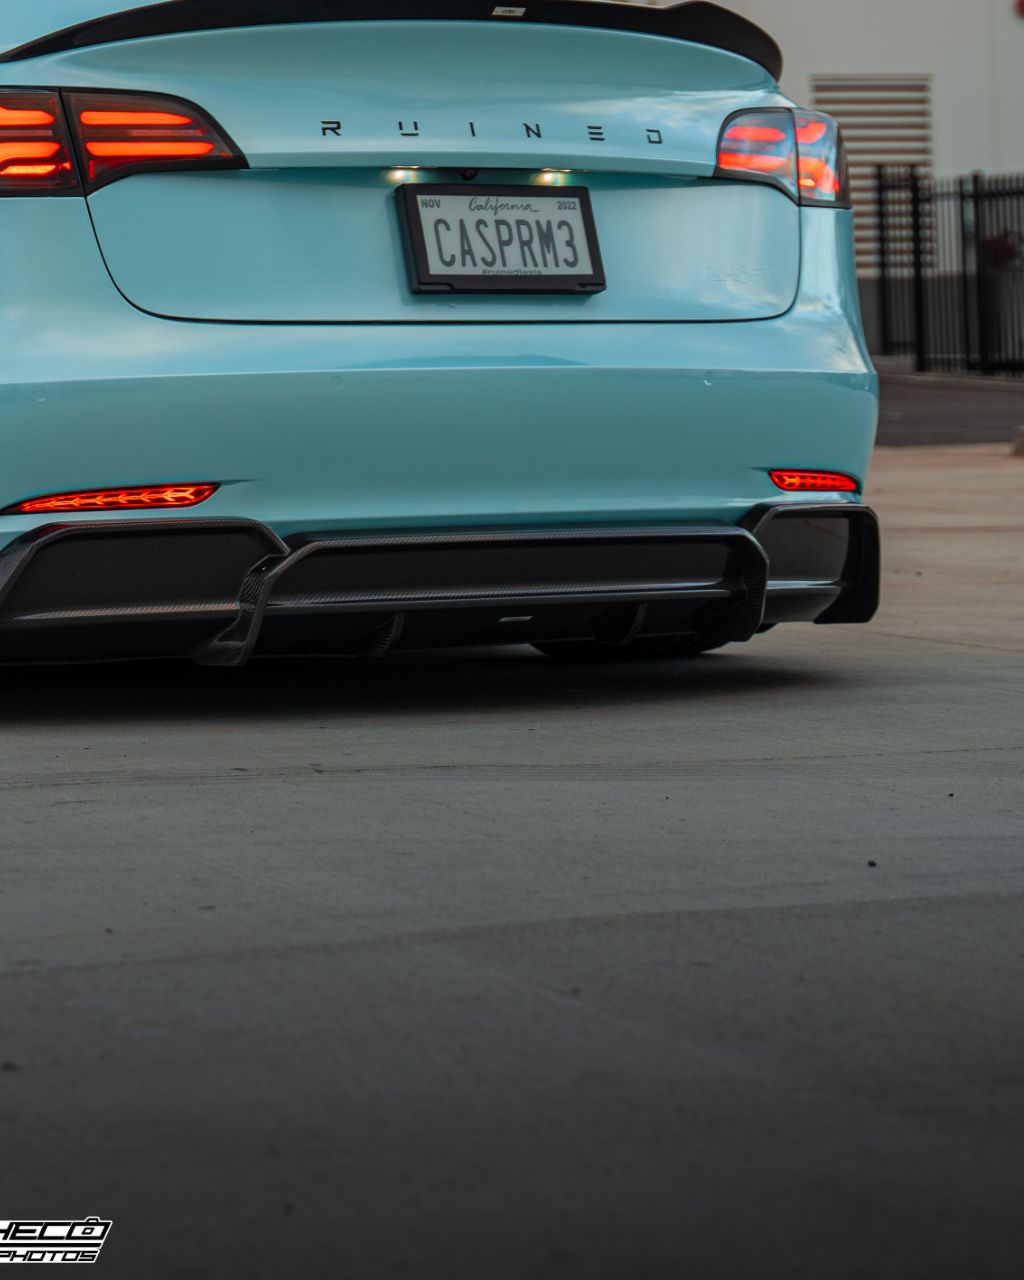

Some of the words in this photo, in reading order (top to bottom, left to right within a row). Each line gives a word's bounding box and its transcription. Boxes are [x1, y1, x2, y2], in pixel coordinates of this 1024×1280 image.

[321, 120, 663, 145] RUINED
[420, 198, 441, 209] NOV
[469, 196, 540, 216] California
[556, 200, 578, 211] 2022
[433, 218, 579, 268] CASPRM3
